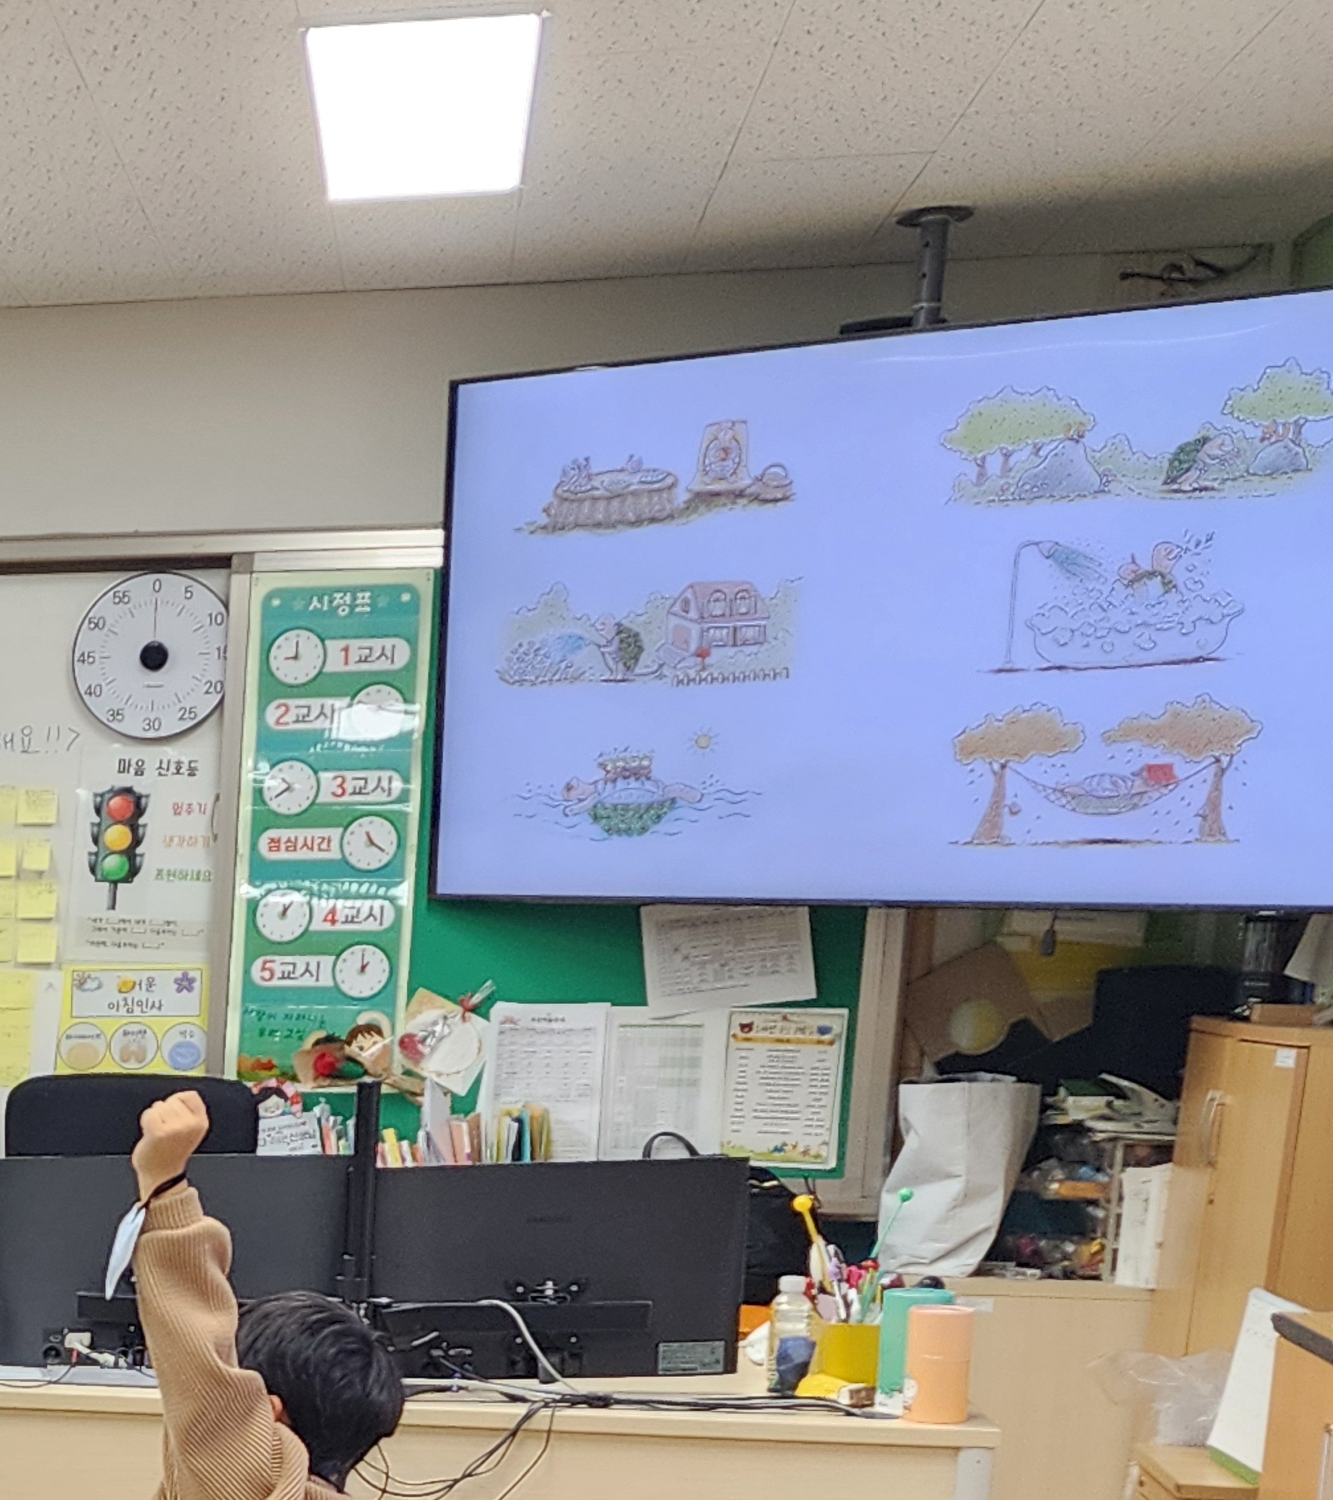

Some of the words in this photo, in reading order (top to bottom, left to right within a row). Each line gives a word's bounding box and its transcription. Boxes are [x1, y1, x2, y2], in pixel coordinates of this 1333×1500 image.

[153, 578, 162, 593] 0
[184, 585, 194, 600] 5
[113, 590, 130, 605] 55
[309, 592, 371, 616] 시정표
[88, 616, 106, 631] 50
[208, 612, 225, 626] 10
[77, 650, 96, 665] 45
[340, 644, 396, 666] 1교시
[84, 684, 103, 697] 40
[204, 680, 224, 694] 20
[107, 708, 125, 722] 35
[178, 706, 197, 721] 25
[273, 702, 335, 726] 2교시
[142, 718, 162, 732] 30
[117, 758, 146, 777] 마음
[155, 758, 199, 777] 신호등
[331, 775, 393, 797] 3교시
[267, 835, 332, 853] 점심시간
[322, 905, 385, 926] 4교시
[260, 960, 321, 982] 5교시
[108, 997, 164, 1014] 아침인사
